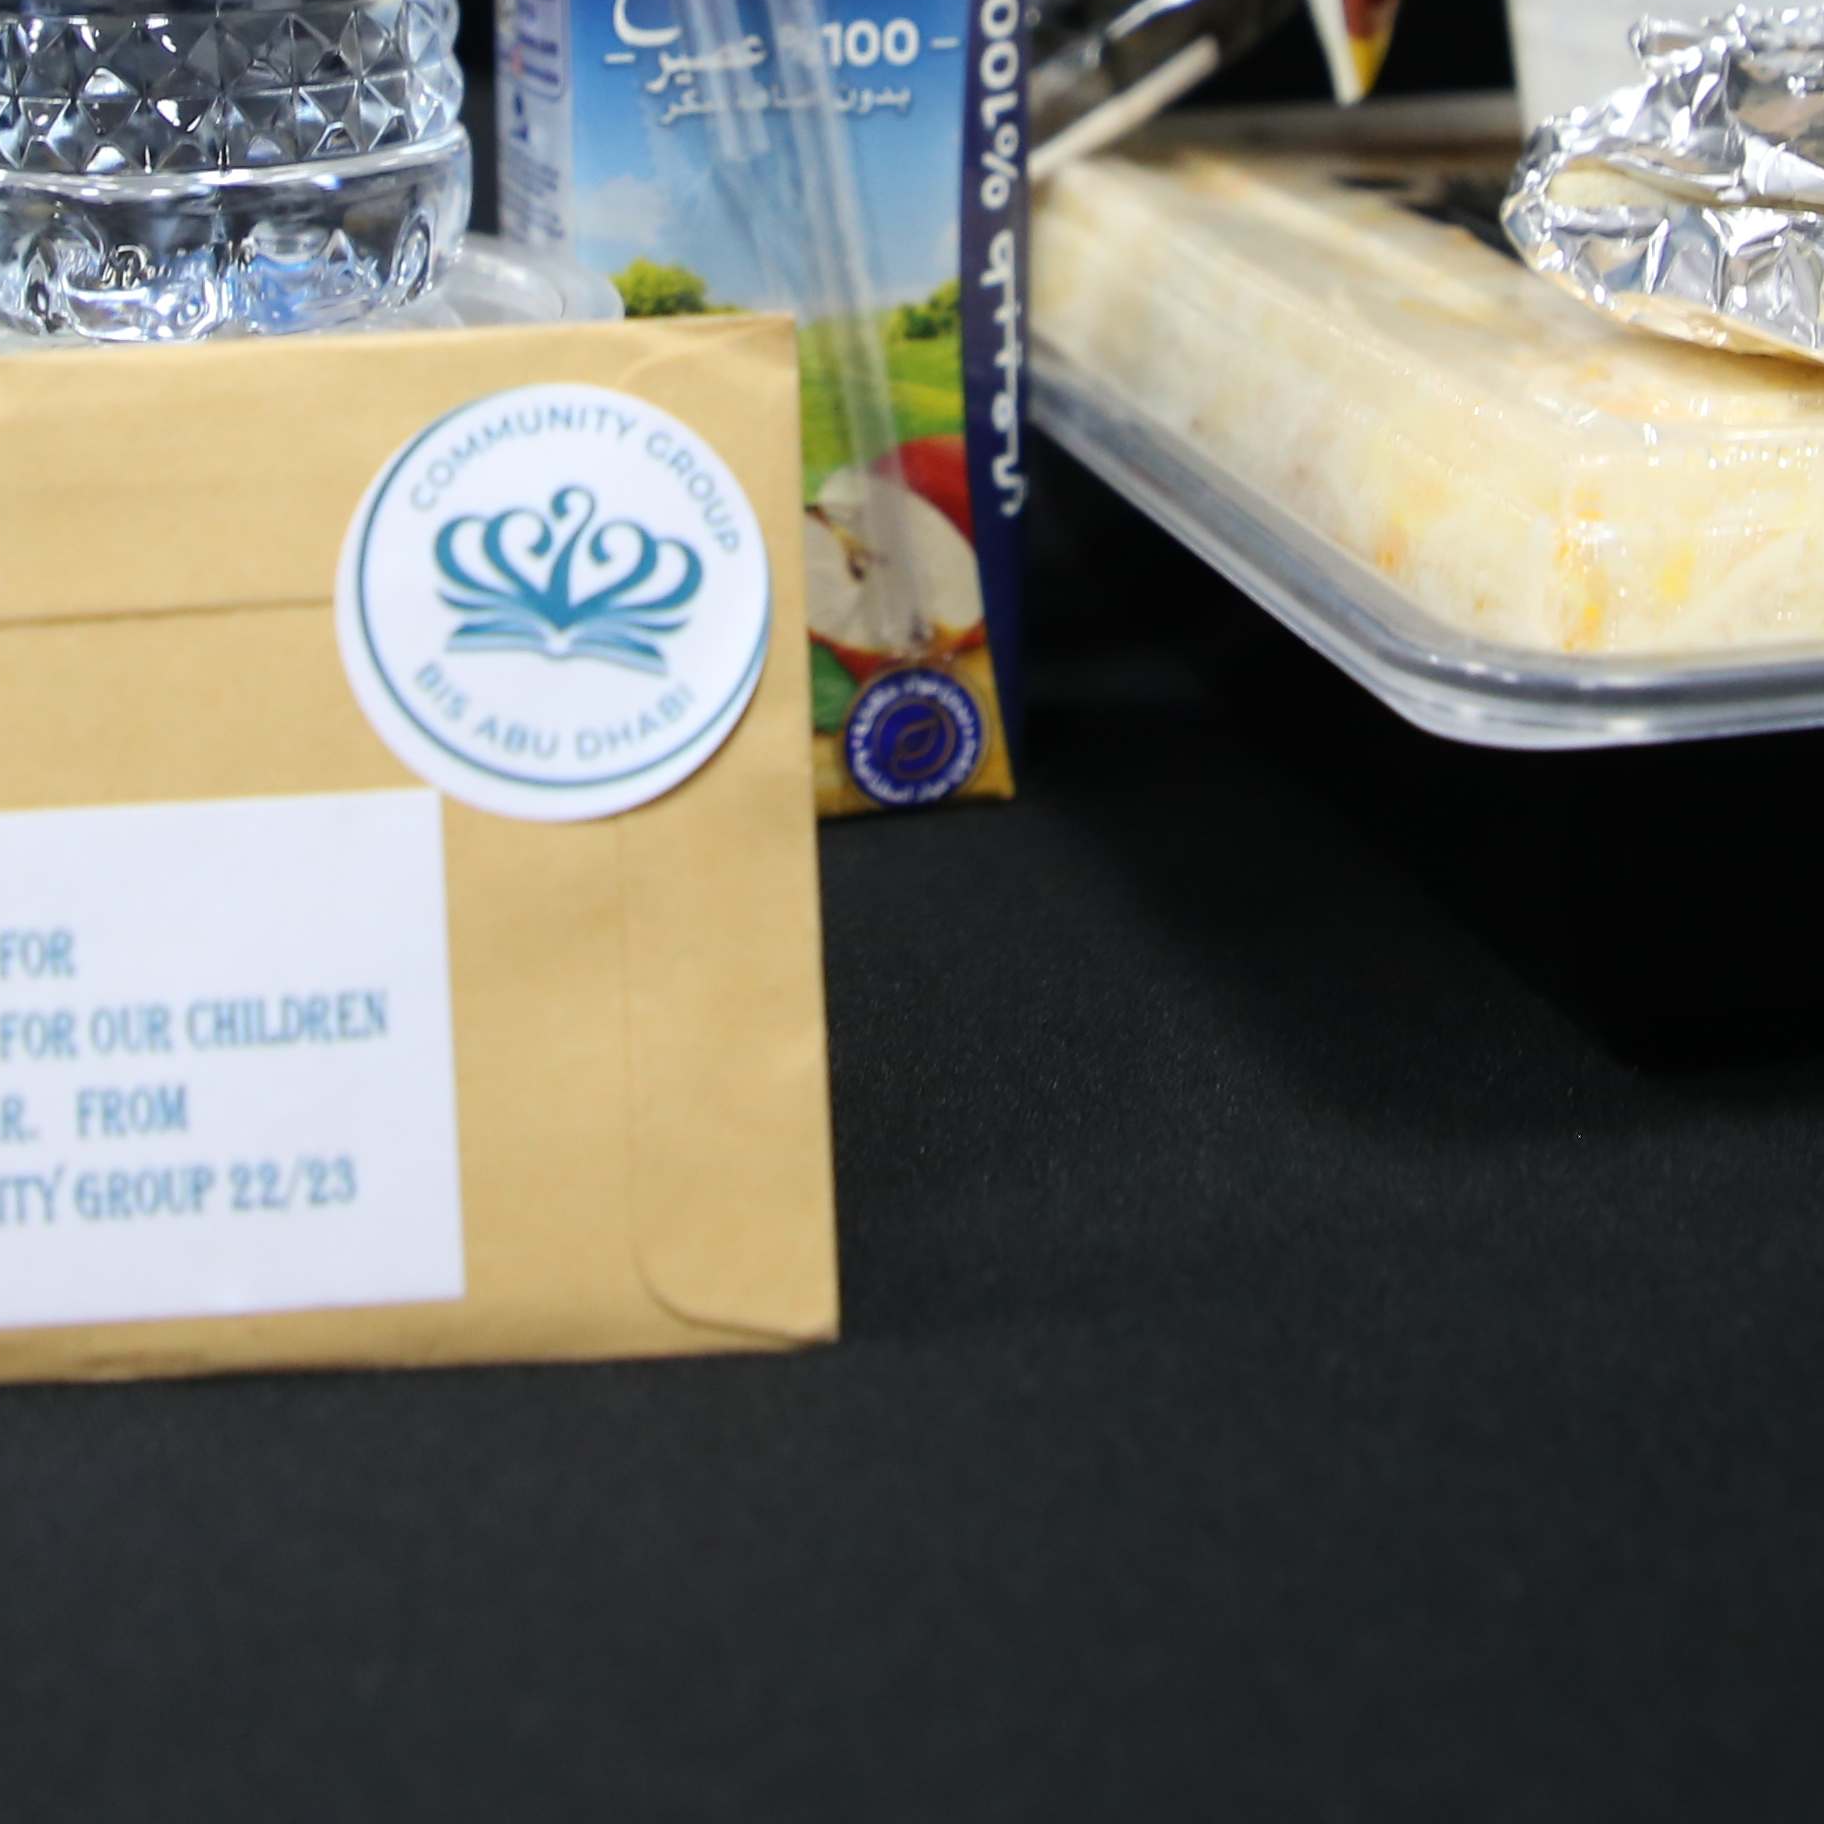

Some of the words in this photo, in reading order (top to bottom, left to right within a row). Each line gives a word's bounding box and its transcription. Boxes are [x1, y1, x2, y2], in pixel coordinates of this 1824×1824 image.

[980, 228, 1027, 519] طبيعي
[408, 404, 637, 513] COMMUNITY
[644, 430, 743, 556] GROUP
[413, 660, 468, 724] BIS
[475, 712, 561, 762] ABU
[574, 682, 699, 762] DHABI
[90, 1006, 172, 1049] OUR
[185, 991, 388, 1046] CHILDREN
[75, 1086, 188, 1136] FROM
[72, 1165, 216, 1219] GROUP
[229, 1157, 357, 1211] 22/23
